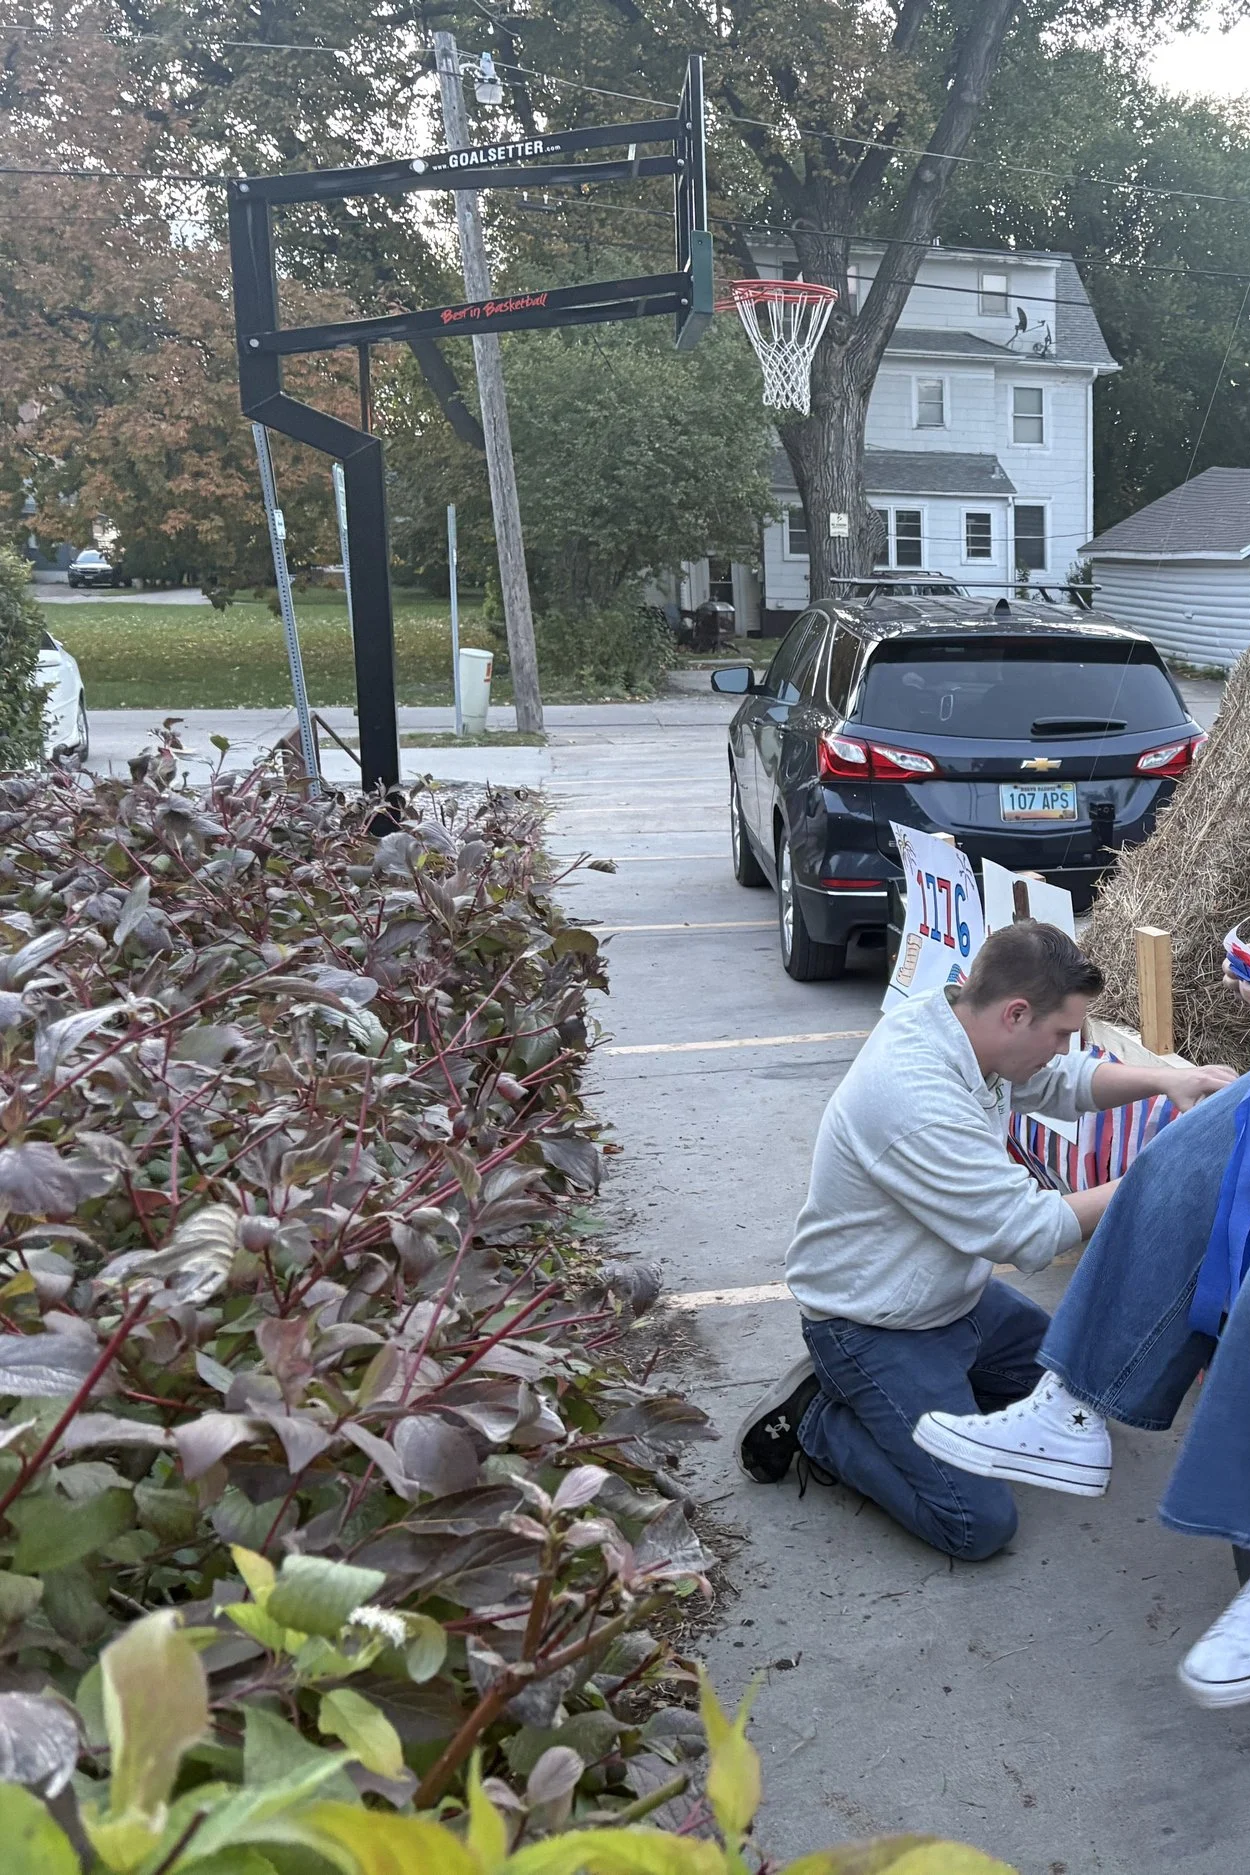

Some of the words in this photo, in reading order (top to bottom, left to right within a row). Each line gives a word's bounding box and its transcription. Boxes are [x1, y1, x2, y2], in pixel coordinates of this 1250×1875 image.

[432, 140, 561, 171] www.GOALSETTER.com
[483, 293, 548, 317] Basketball
[1009, 792, 1035, 810] 107
[1042, 792, 1069, 810] APS
[917, 869, 970, 957] 1776
